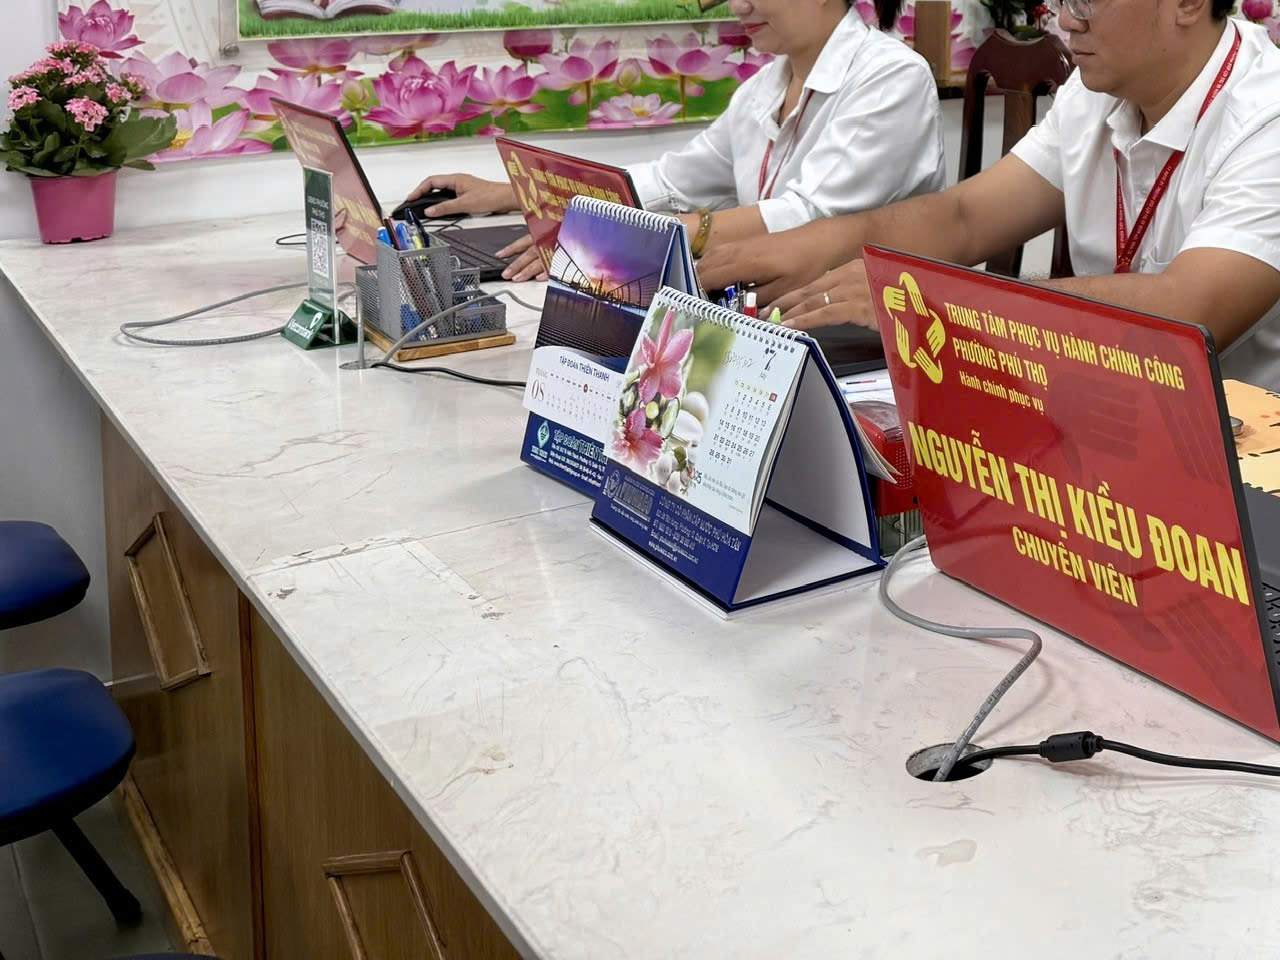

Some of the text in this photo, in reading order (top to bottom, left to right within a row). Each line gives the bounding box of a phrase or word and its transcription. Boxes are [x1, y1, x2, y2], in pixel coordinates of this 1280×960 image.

[944, 301, 1186, 391] TRUNG TÂM PHỤC VỤ HÀNH CHÍNH CÔNG
[953, 336, 1049, 391] PHƯỜNG PHÚ THỌ
[960, 370, 1045, 416] Hành chính phục vụ
[907, 421, 1251, 606] NGUYỄN THỊ KIỀU ĐOAN
[1012, 525, 1139, 608] CHUYÊN VIÊN
